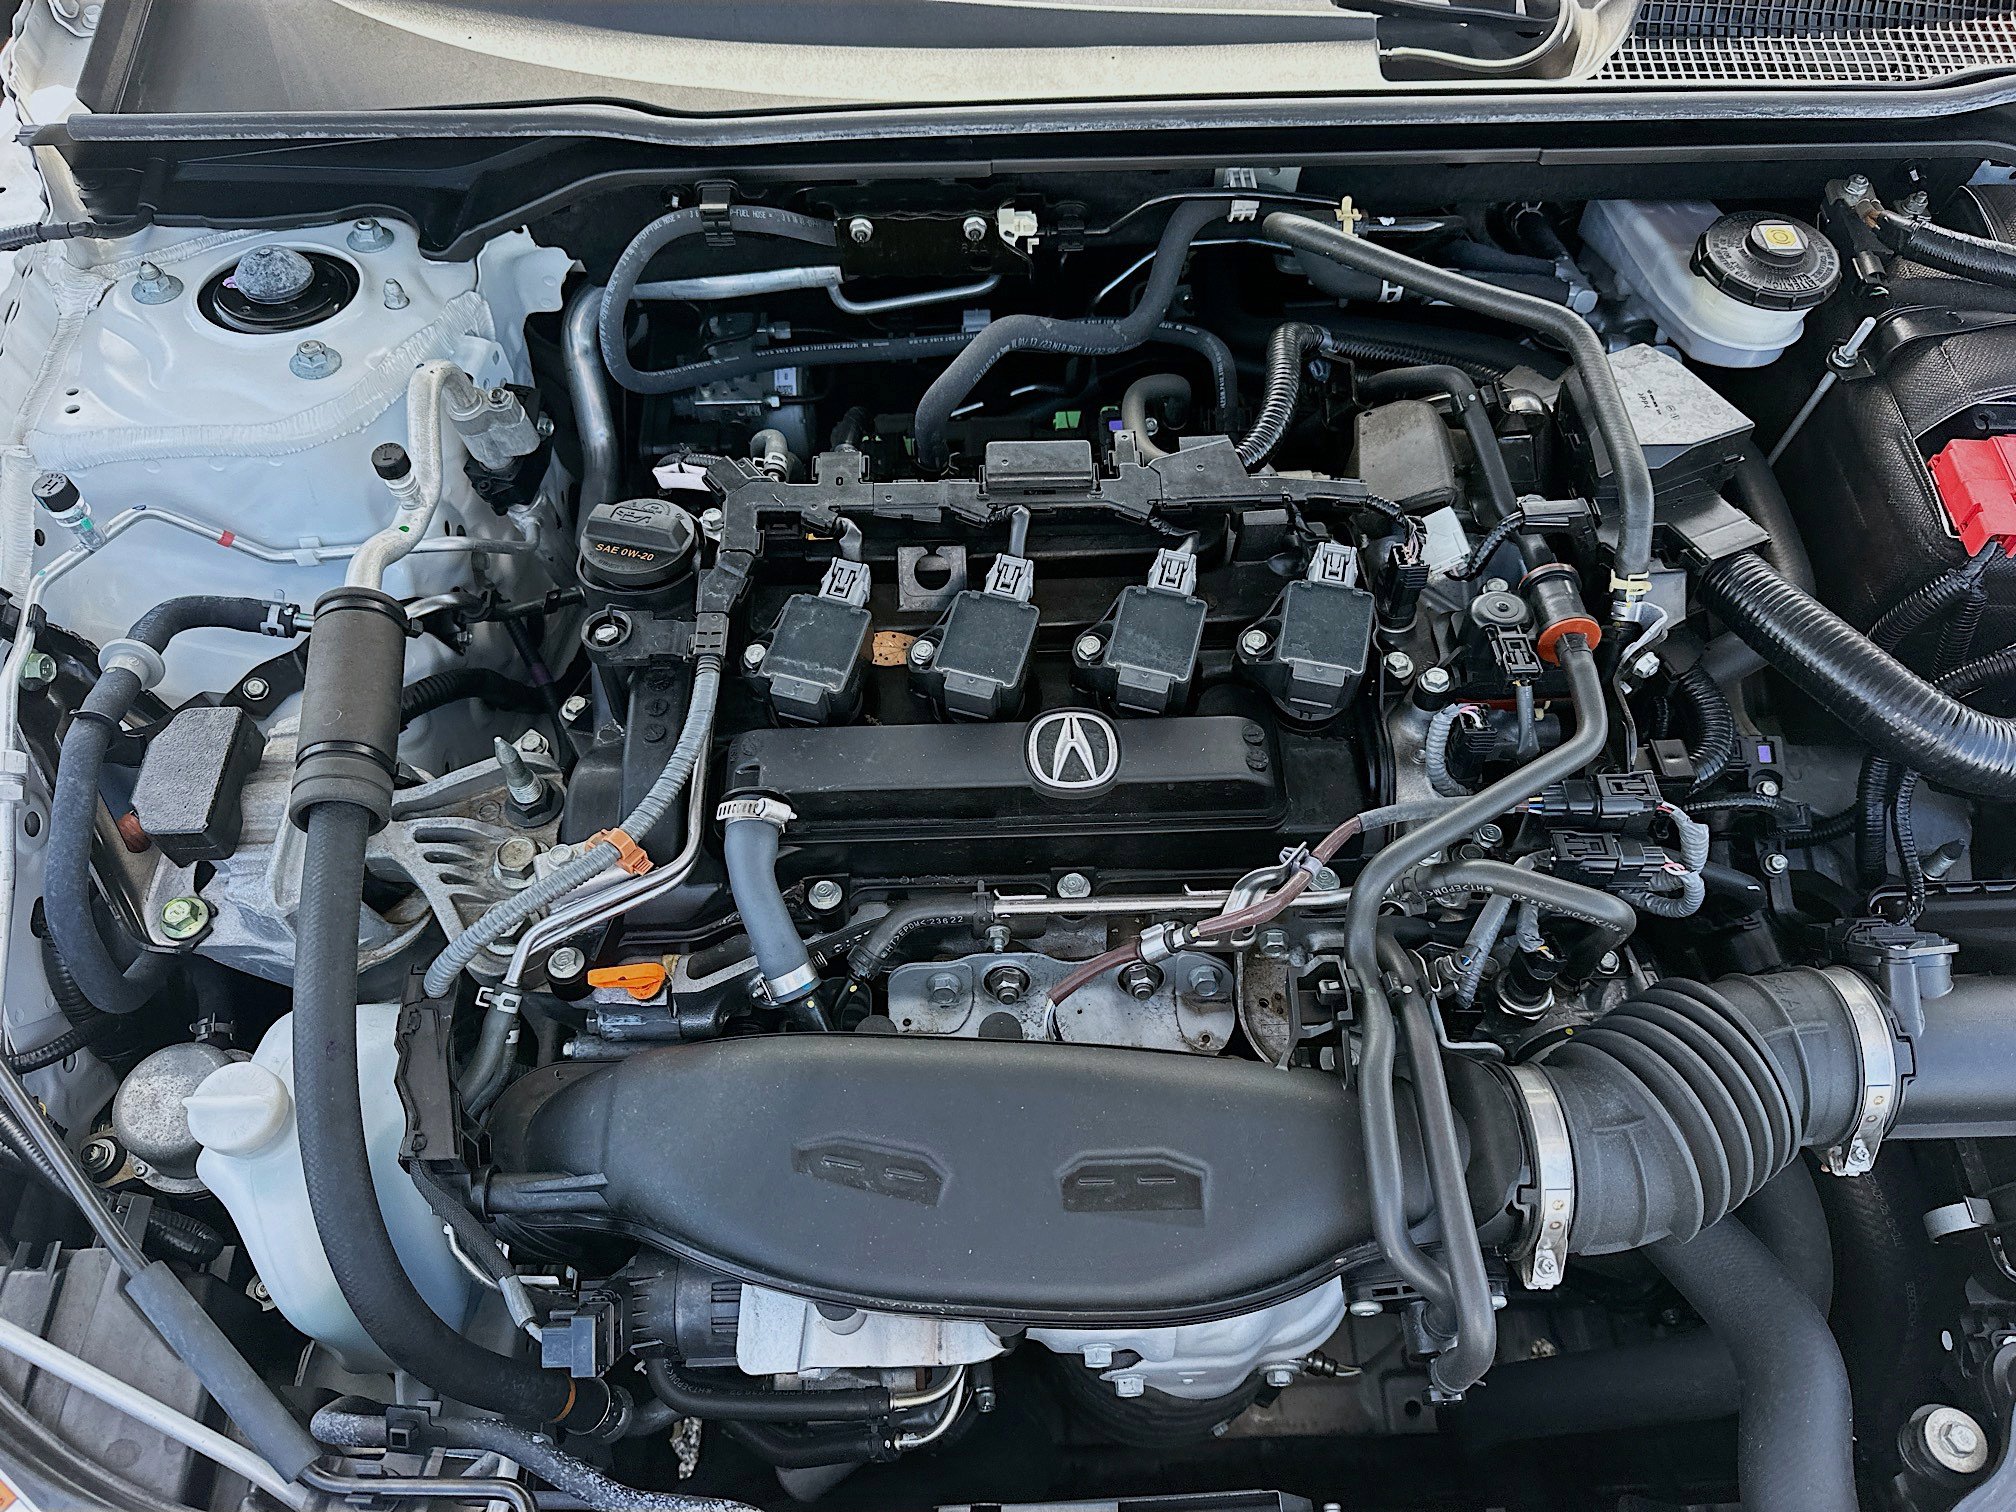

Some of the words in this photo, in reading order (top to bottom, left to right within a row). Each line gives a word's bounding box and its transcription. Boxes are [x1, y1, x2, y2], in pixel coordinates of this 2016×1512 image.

[752, 210, 766, 219] HOSE
[1764, 275, 1818, 291] ATTENTION
[595, 543, 621, 555] SAE
[620, 548, 655, 561] 0W-20
